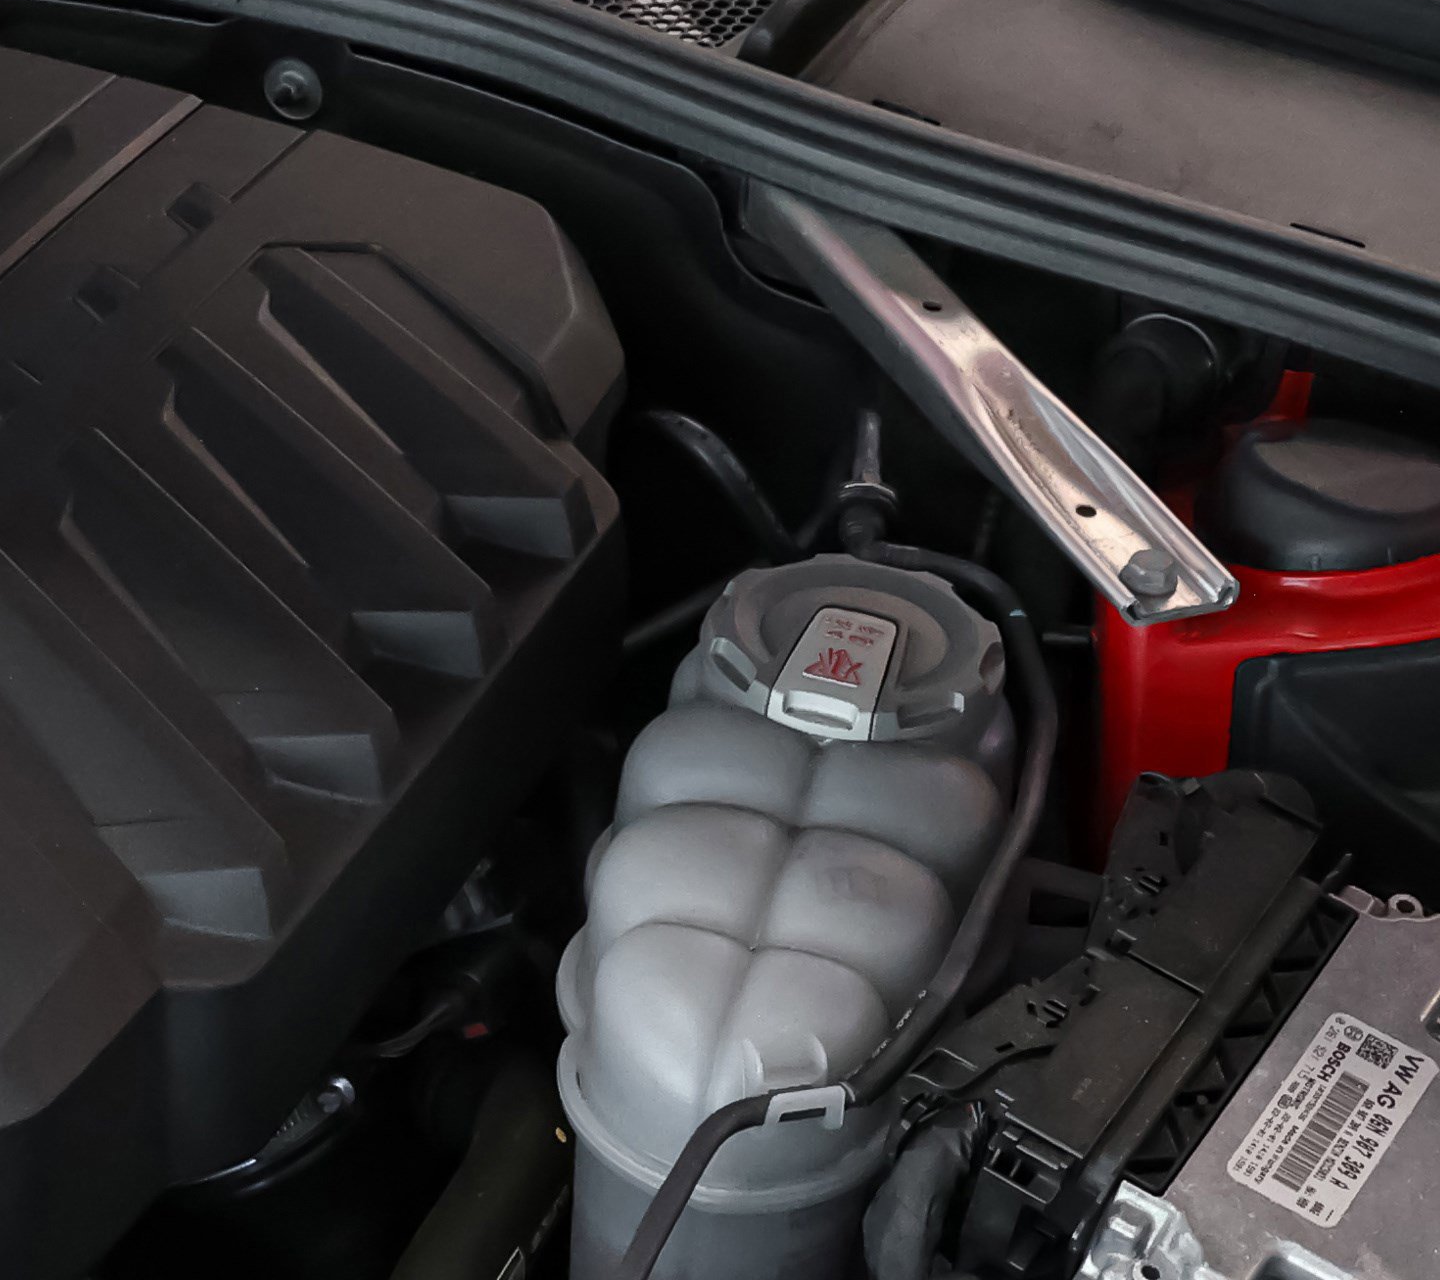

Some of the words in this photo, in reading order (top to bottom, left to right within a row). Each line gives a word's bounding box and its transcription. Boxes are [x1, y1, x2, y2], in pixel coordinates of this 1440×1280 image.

[1317, 1041, 1352, 1082] BOSCH
[1394, 1055, 1425, 1085] VW
[1376, 1080, 1403, 1109] AG
[1366, 1113, 1393, 1137] 06N
[1352, 1134, 1379, 1159] 907
[1337, 1155, 1365, 1180] 309
[1329, 1177, 1349, 1190] A
